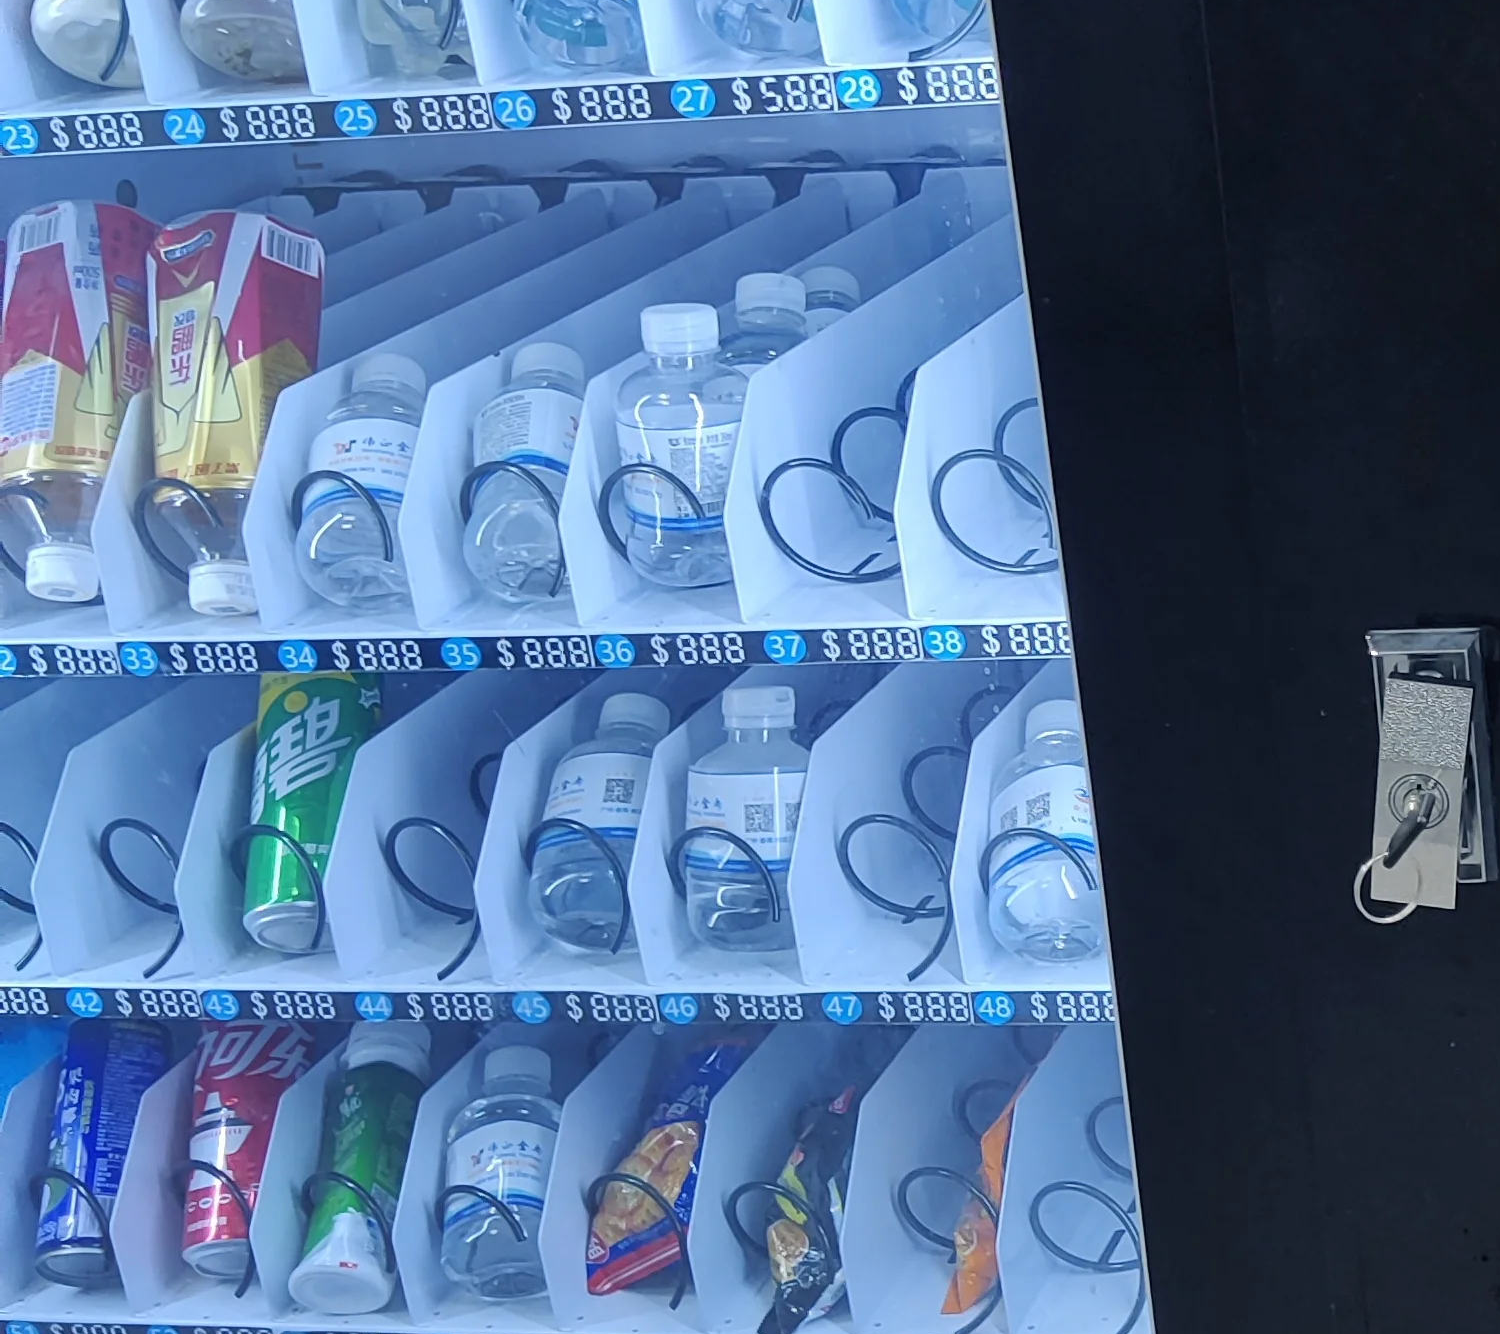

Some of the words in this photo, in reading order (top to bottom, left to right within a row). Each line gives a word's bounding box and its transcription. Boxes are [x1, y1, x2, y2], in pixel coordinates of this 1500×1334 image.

[677, 87, 710, 112] 27
[841, 77, 876, 103] 28
[499, 96, 535, 122] 26
[169, 115, 201, 140] 24
[600, 640, 633, 660] 36
[769, 635, 800, 656] 37
[929, 632, 962, 654] 38
[283, 647, 314, 667] 34
[207, 996, 237, 1014] 43
[664, 997, 696, 1016] 46
[827, 997, 859, 1017] 47
